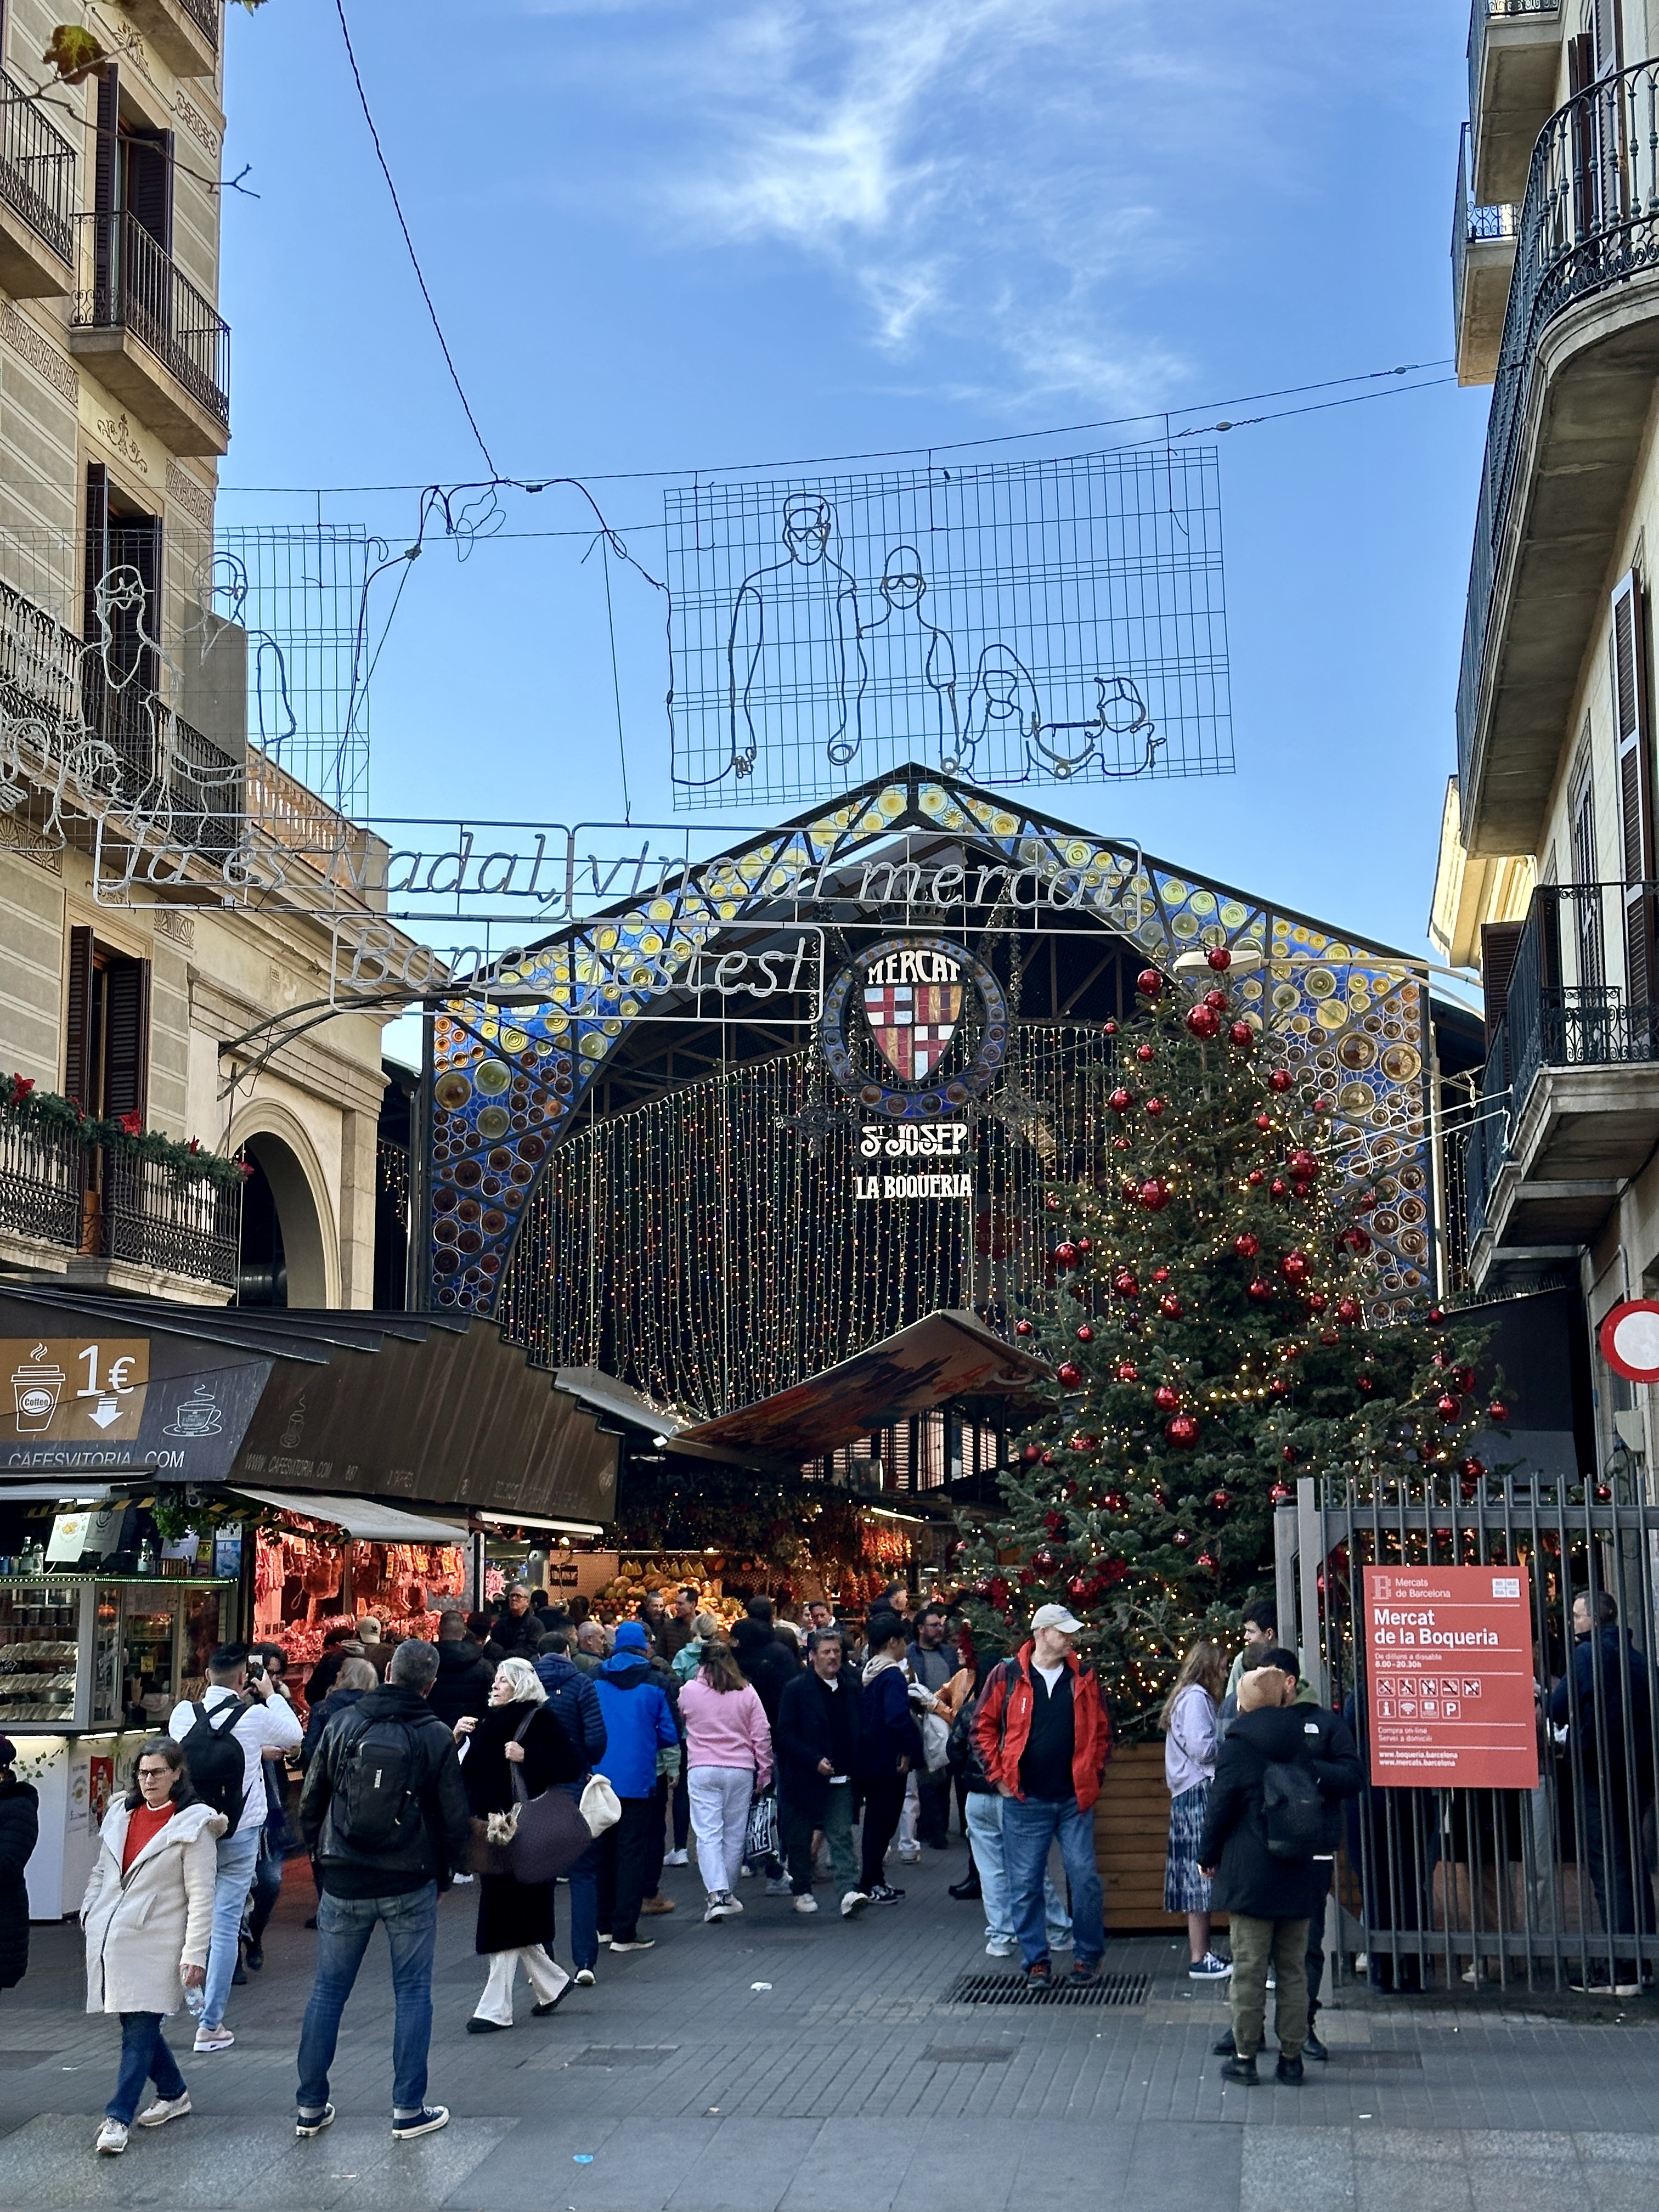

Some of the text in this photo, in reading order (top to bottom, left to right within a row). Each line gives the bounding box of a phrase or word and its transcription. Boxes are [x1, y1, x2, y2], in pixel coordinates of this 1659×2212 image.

[588, 840, 738, 900] vine
[768, 840, 835, 901] al
[859, 861, 1121, 913] mercat
[341, 926, 563, 990] Bones
[868, 950, 961, 984] MERCAT
[885, 1124, 967, 1156] JOSEP
[856, 1174, 973, 1199] LA BOQUERIA
[77, 1345, 136, 1396] 1€
[24, 1398, 49, 1407] Coffee
[1395, 1578, 1428, 1587] Mercats
[1396, 1589, 1451, 1598] de Barcelona
[1374, 1609, 1435, 1626] Mercat
[1374, 1628, 1498, 1648] de la Boqueria
